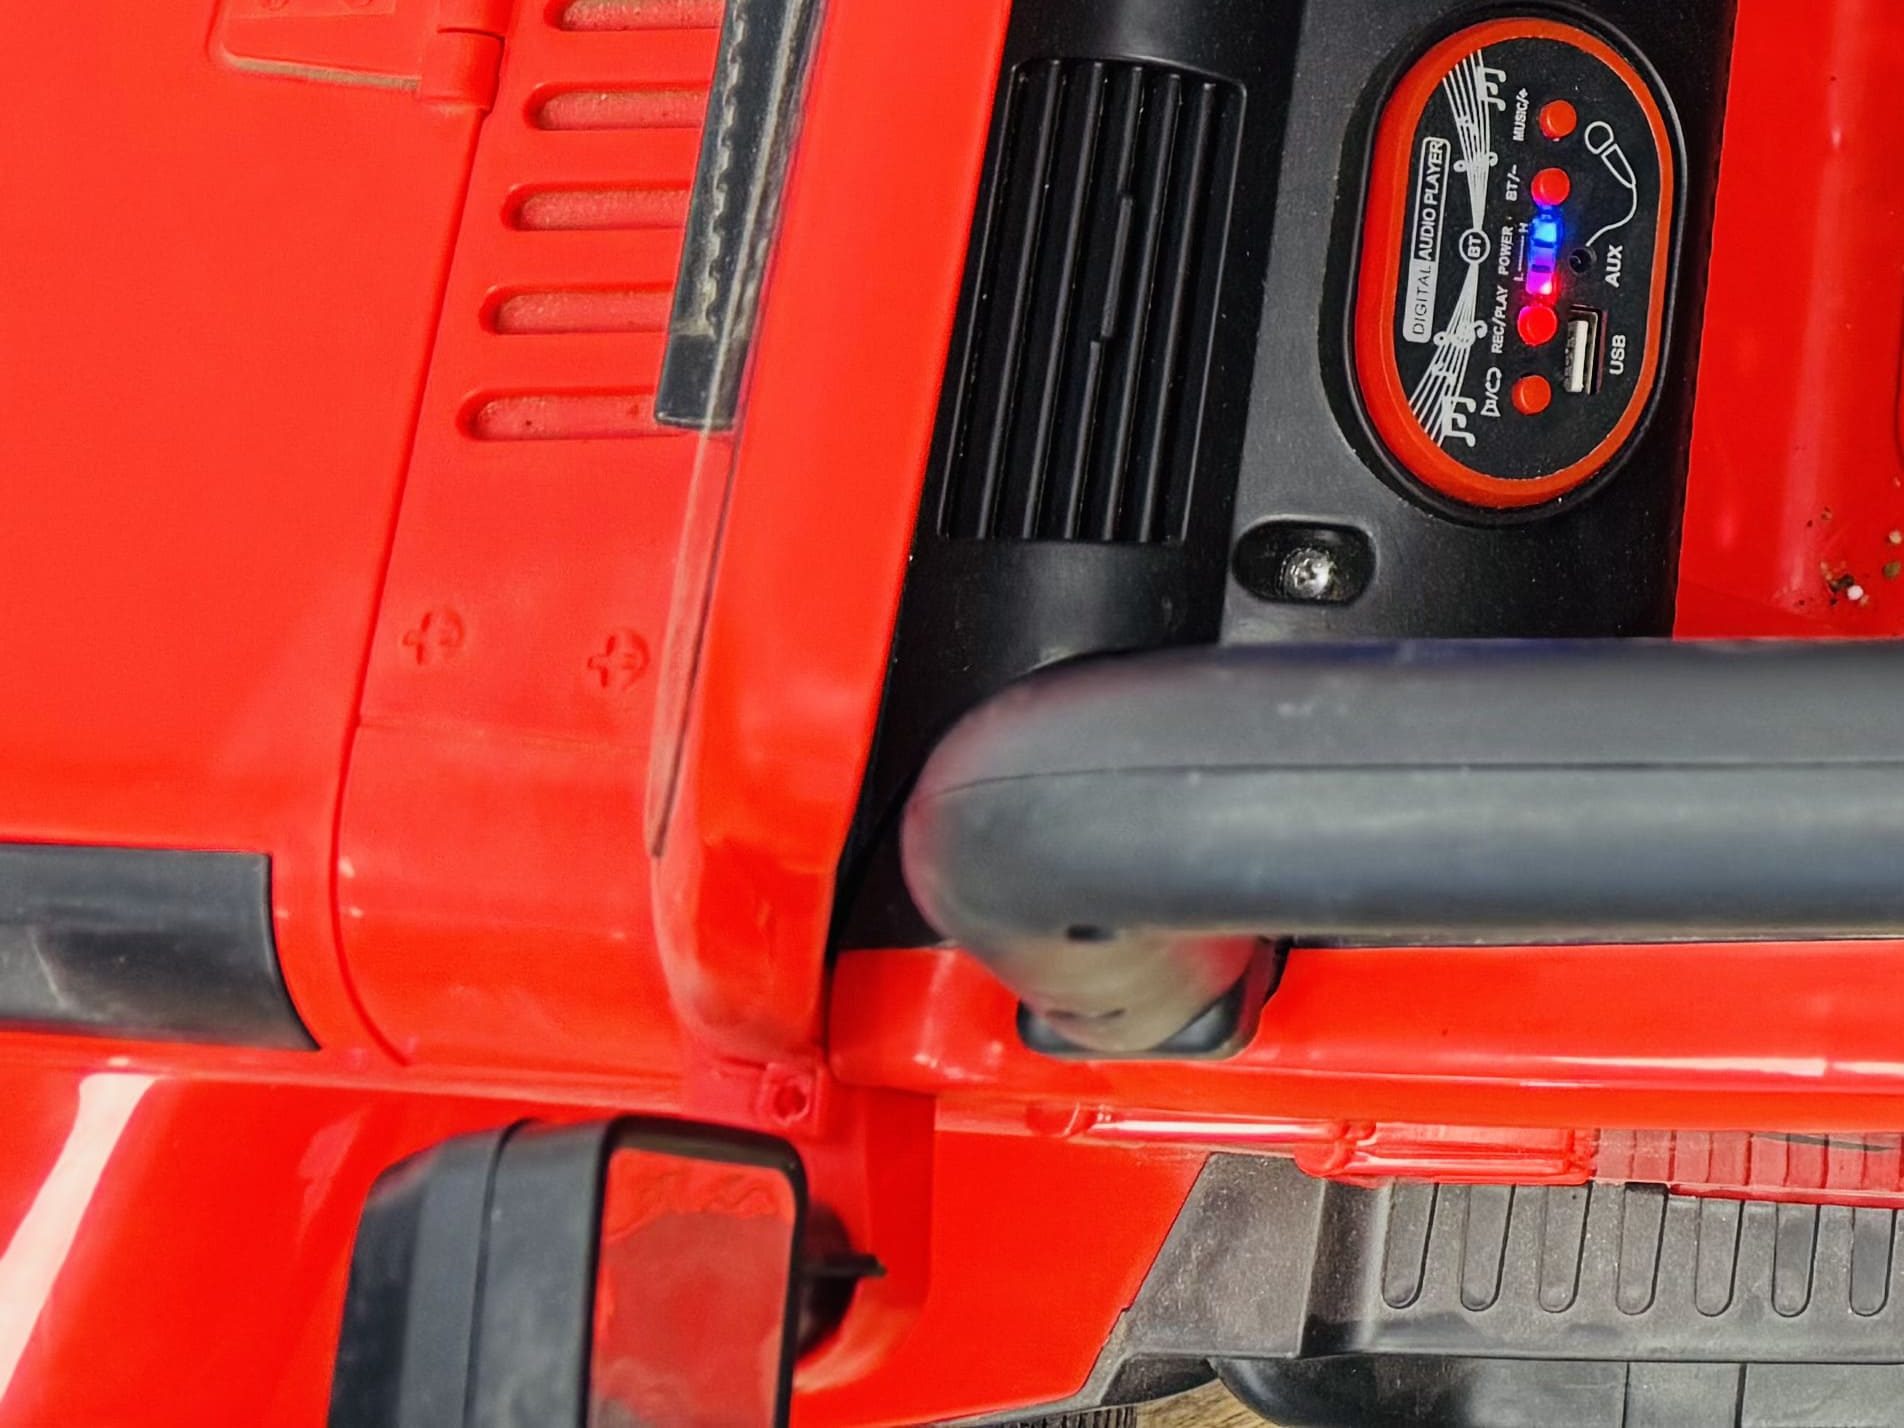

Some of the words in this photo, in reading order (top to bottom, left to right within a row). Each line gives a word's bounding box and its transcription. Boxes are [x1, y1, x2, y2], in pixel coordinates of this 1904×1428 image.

[1425, 141, 1443, 205] PLAYER
[1417, 207, 1437, 261] AUDIO
[1467, 234, 1484, 259] BT
[1498, 226, 1514, 276] POWER
[1605, 244, 1624, 287] AUX
[1411, 265, 1432, 336] DIGITAL
[1491, 285, 1510, 354] REC/PLAY
[1610, 333, 1625, 375] USB
